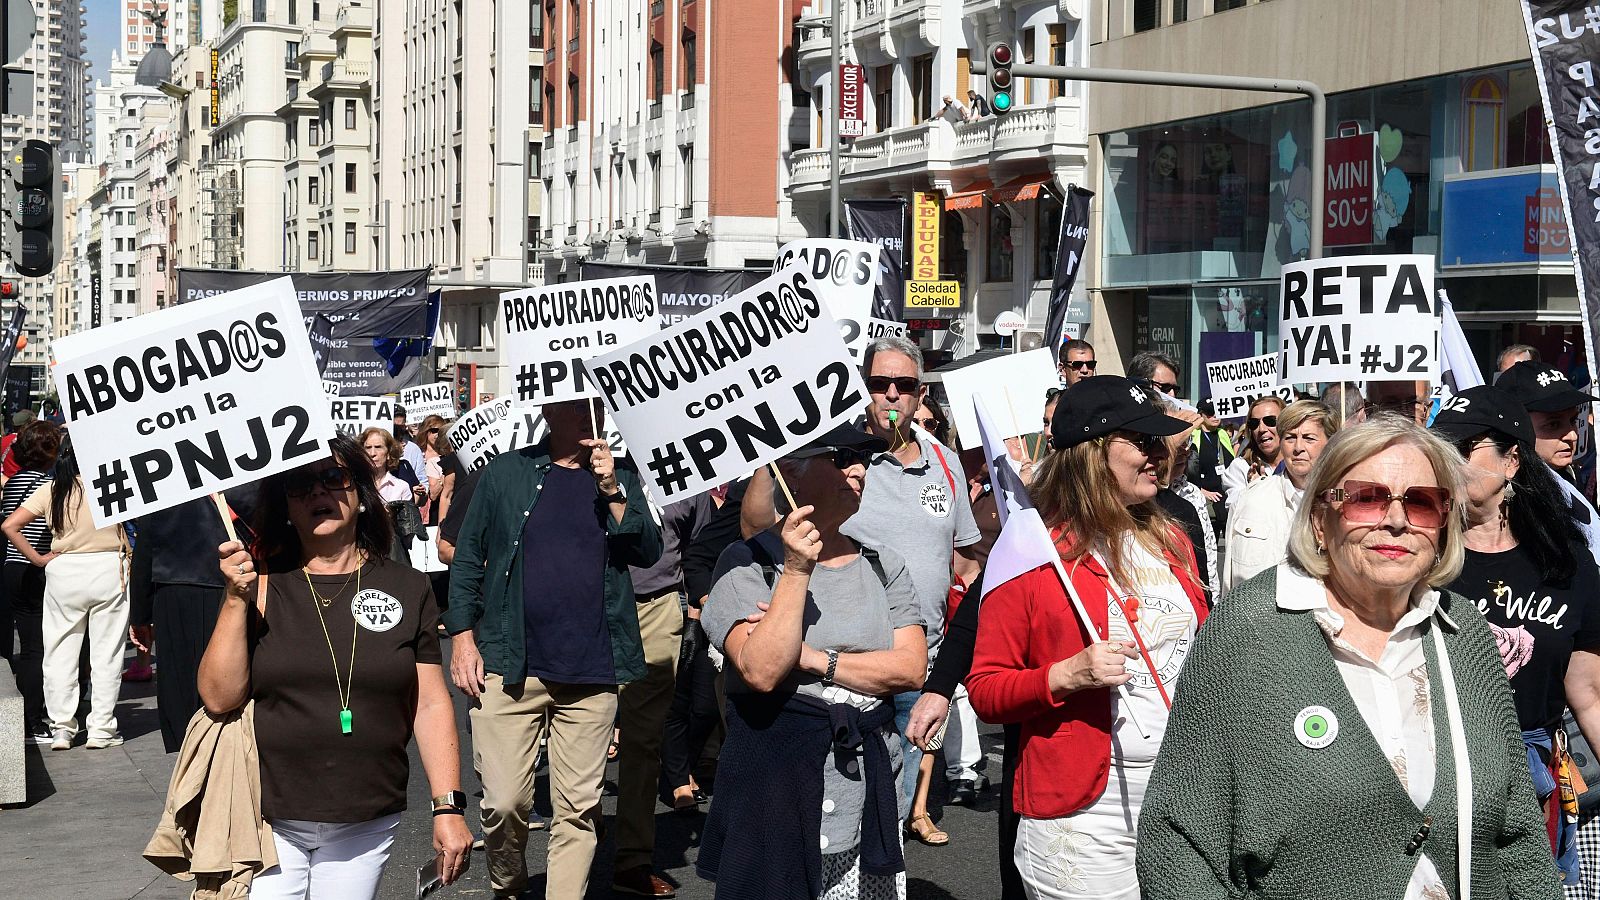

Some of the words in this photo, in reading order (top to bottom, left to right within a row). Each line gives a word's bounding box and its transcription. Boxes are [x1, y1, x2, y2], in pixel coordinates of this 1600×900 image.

[844, 66, 857, 119] EXCELSIOR
[1327, 160, 1368, 190] MINI
[919, 194, 935, 278] PELUCAS
[296, 290, 349, 301] ERMOS
[353, 287, 416, 300] PRIMERO
[662, 292, 737, 307] MAYORÍ
[909, 283, 956, 293] Soledad
[911, 295, 955, 306] Cabello
[1283, 264, 1432, 321] RETA
[503, 282, 655, 334] PROCURADOR@S
[329, 340, 349, 349] NJ2
[548, 335, 590, 352] con
[598, 330, 618, 346] la
[593, 272, 820, 412] PROCURADOR@S
[1152, 327, 1174, 342] GRAN
[1282, 323, 1352, 379] ¡YA!
[1360, 344, 1429, 374] #J2
[66, 311, 287, 421] ABOGAD@S
[516, 356, 601, 402] #PN
[1209, 357, 1278, 383] PROCURADOR
[340, 380, 369, 388] LosJ2
[403, 386, 450, 405] #PNJ2
[685, 381, 744, 419] con
[748, 363, 783, 389] la
[1234, 384, 1256, 393] con
[136, 404, 197, 436] con
[203, 392, 238, 415] la
[331, 401, 393, 420] RETA
[470, 436, 487, 453] con
[488, 427, 501, 438] la
[647, 361, 862, 497] #PNJ2
[92, 405, 320, 518] #PNJ2
[930, 503, 946, 512] YA
[362, 605, 391, 613] RETA
[365, 613, 392, 625] YA
[1496, 585, 1568, 629] Wild
